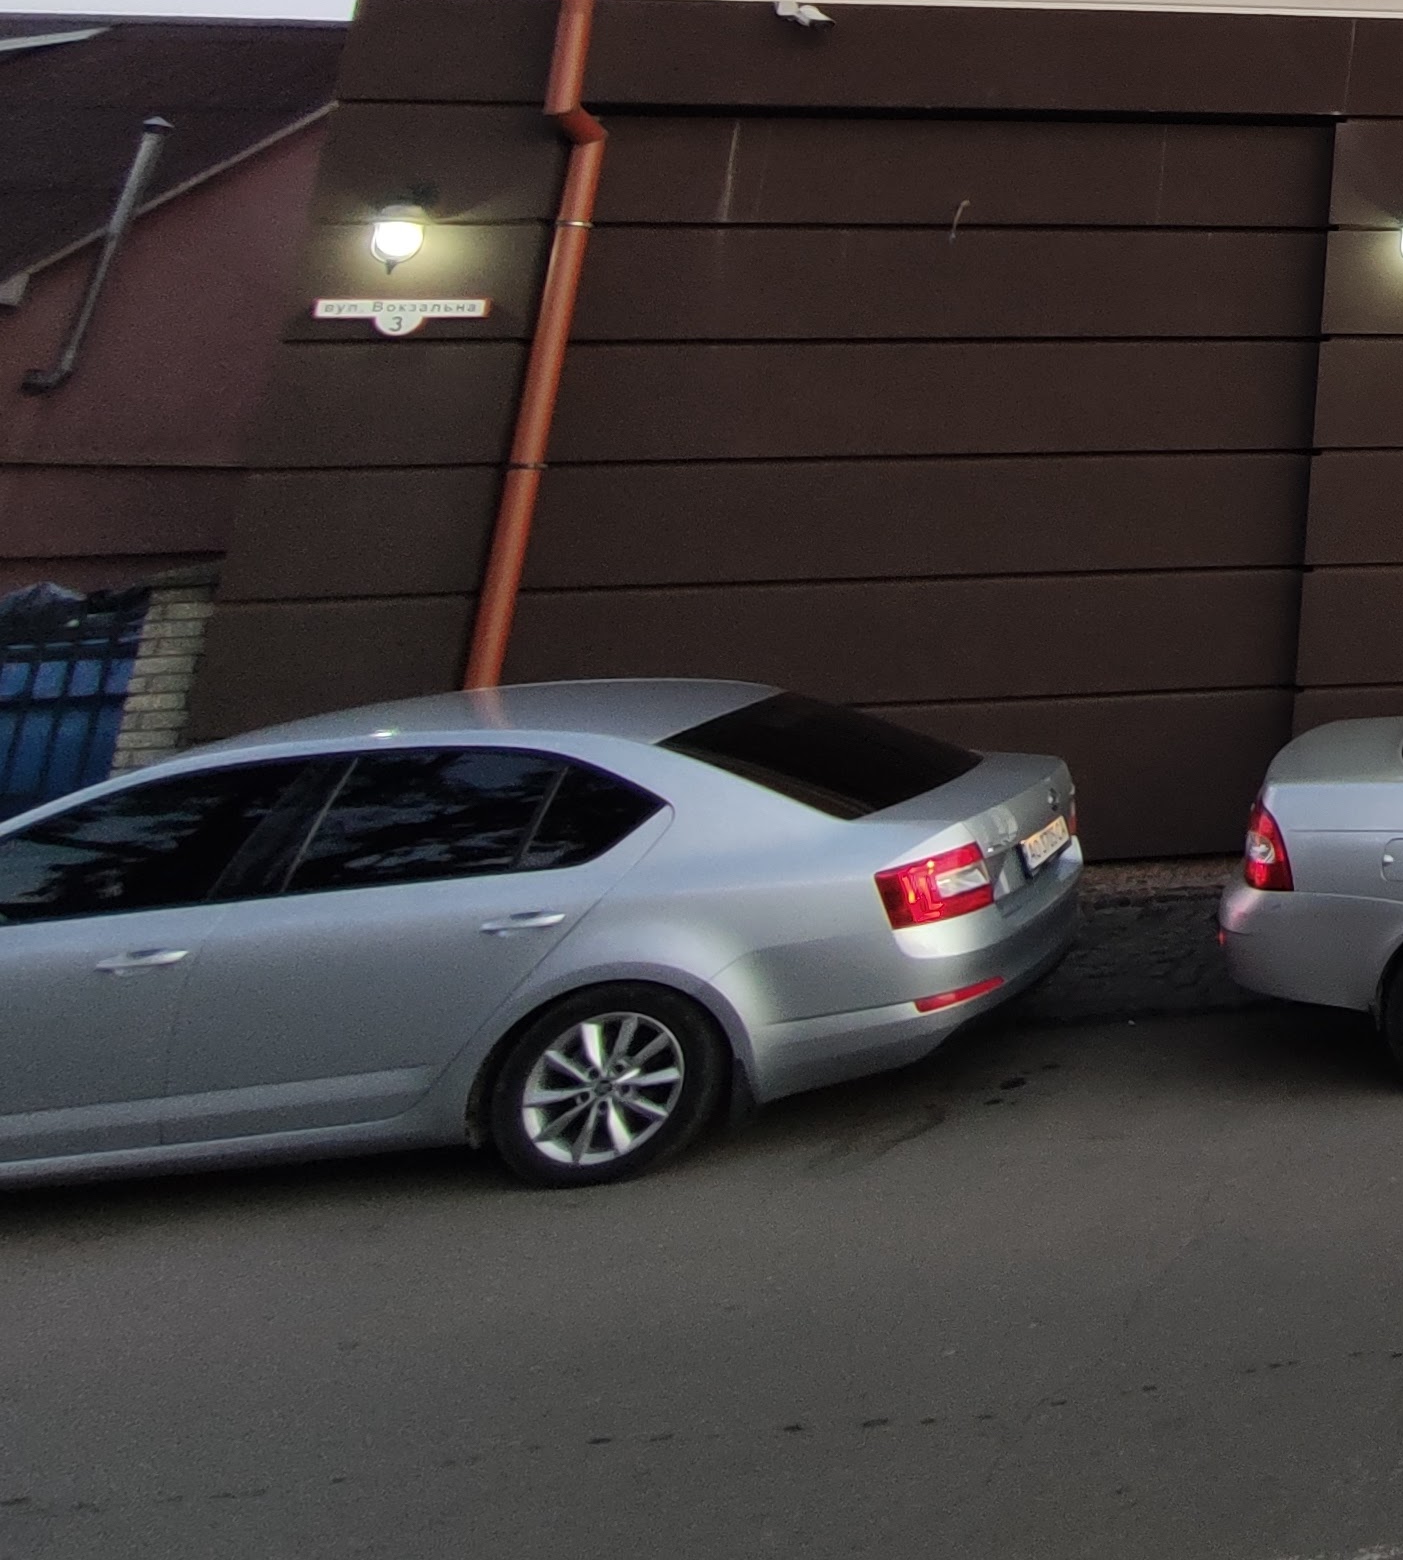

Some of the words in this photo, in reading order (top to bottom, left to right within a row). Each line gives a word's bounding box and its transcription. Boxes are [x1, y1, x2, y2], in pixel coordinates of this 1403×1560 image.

[324, 302, 363, 315] вул.
[372, 301, 477, 313] Вокзальна
[389, 316, 403, 332] 3
